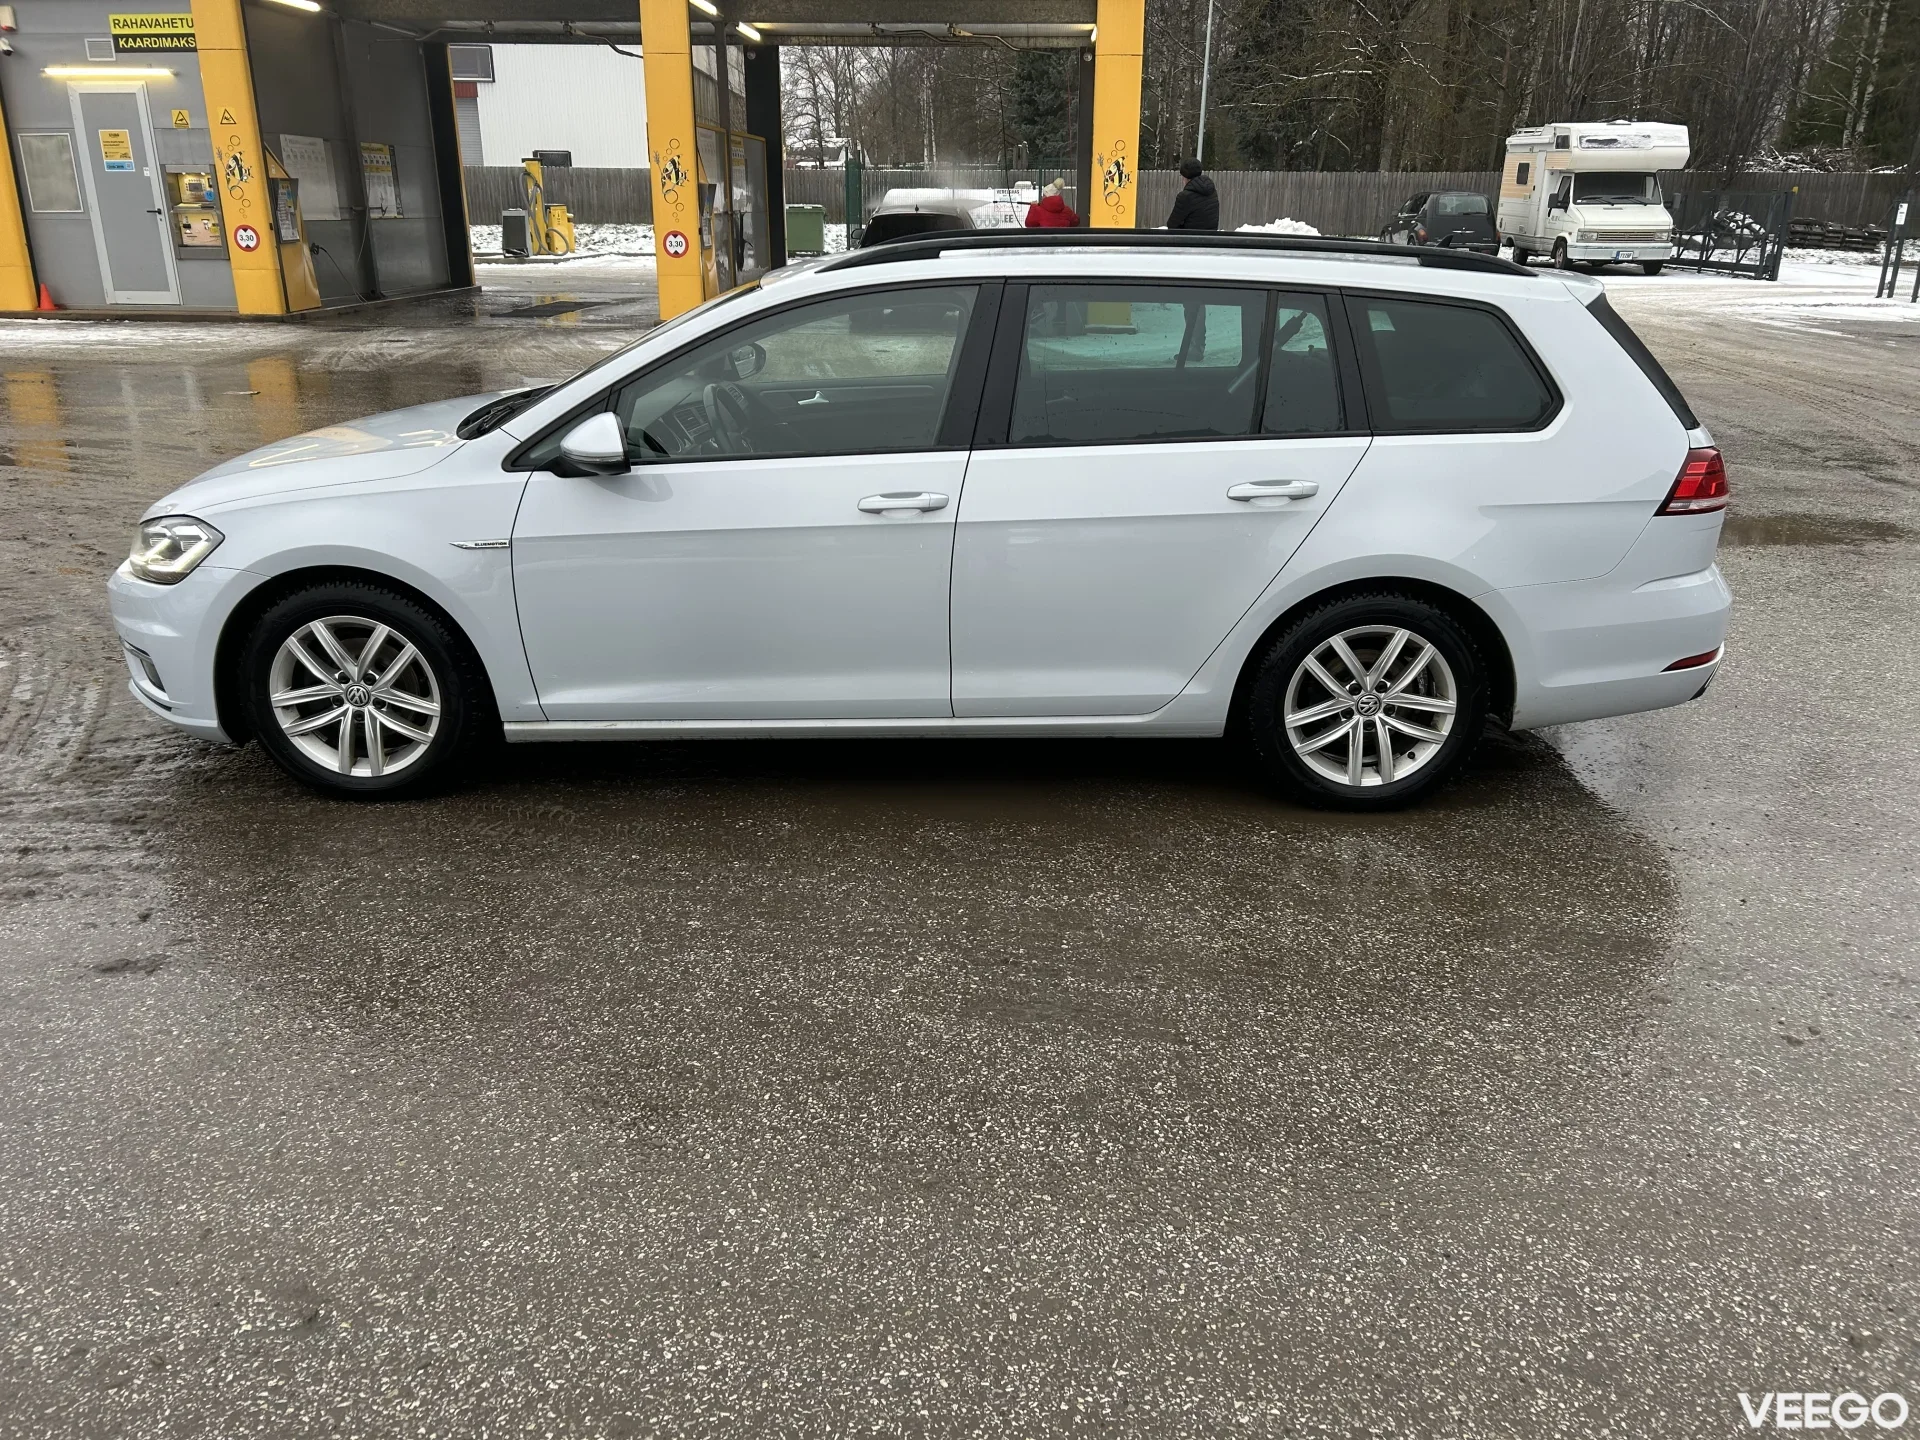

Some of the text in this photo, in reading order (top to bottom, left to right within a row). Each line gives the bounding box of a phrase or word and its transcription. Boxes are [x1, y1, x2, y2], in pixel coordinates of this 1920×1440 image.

[113, 17, 194, 29] RAHAVAHETU
[119, 37, 196, 48] KAARDIMAKS
[239, 234, 254, 243] 3,30
[668, 240, 683, 248] 3,30
